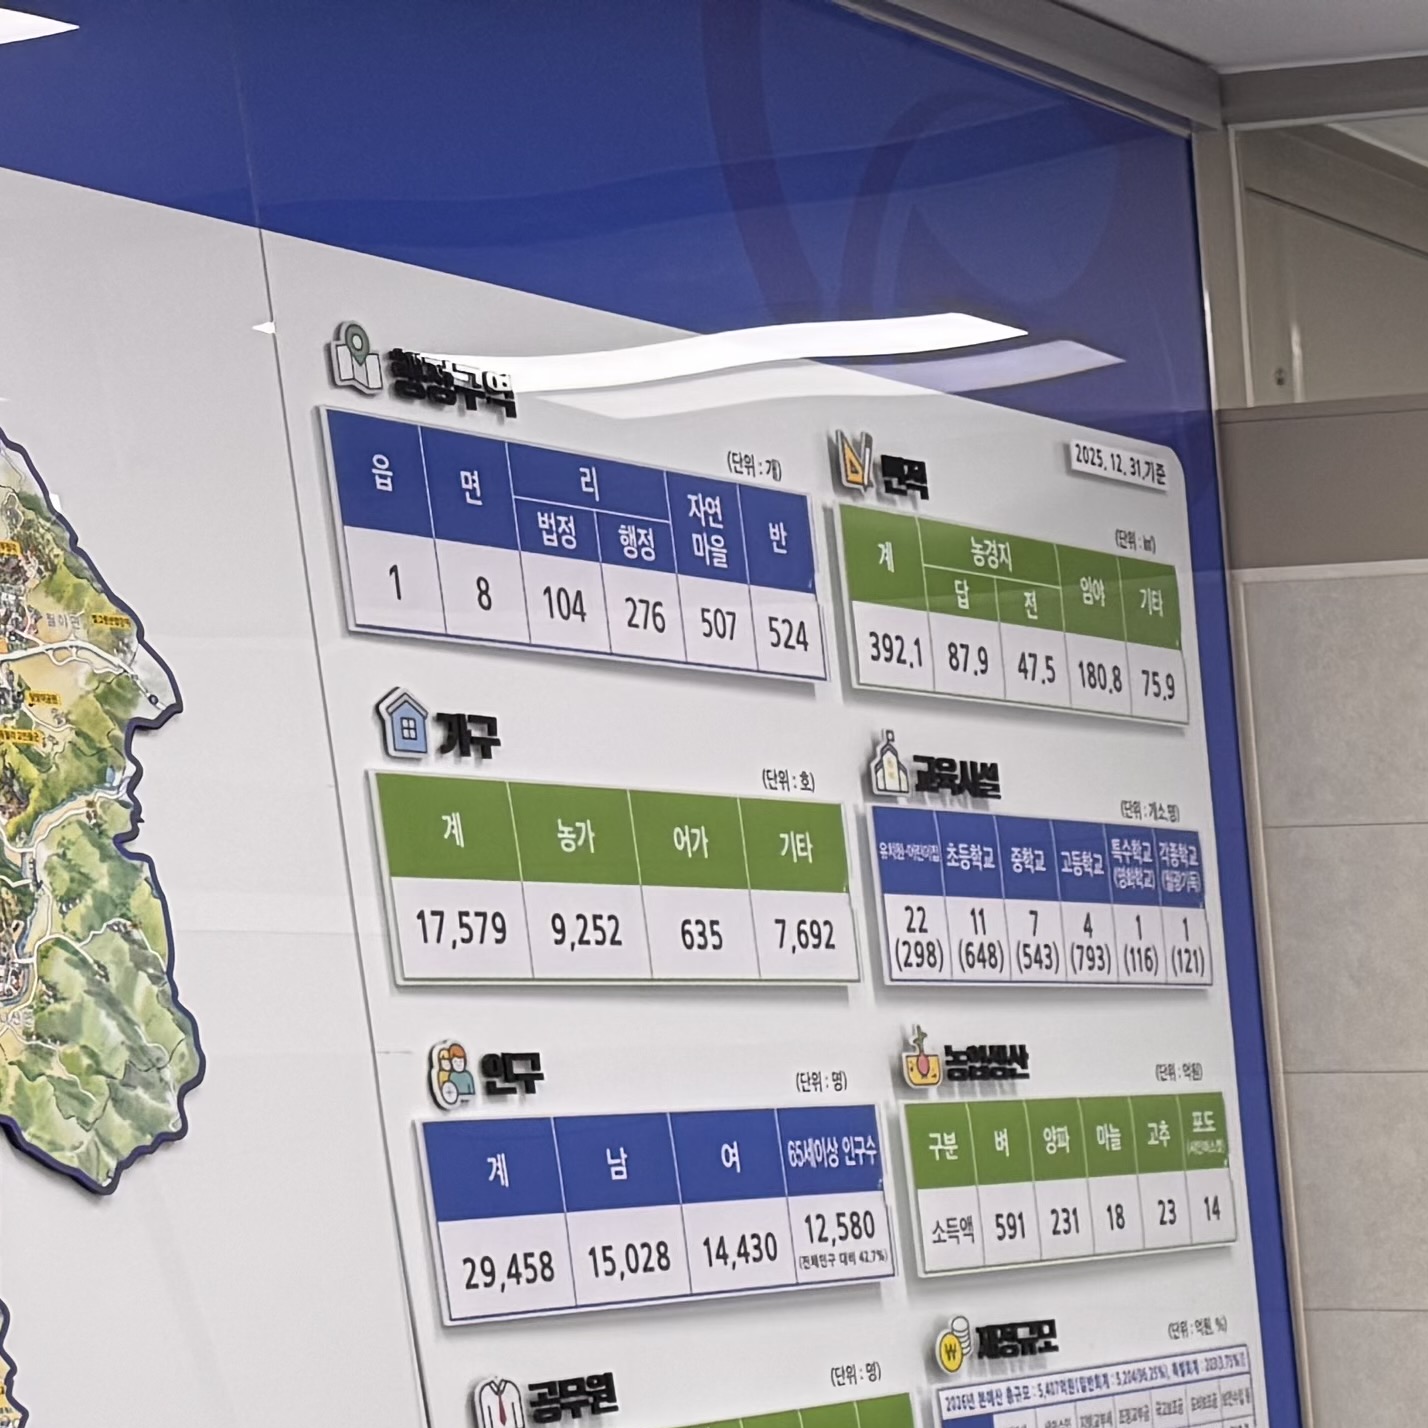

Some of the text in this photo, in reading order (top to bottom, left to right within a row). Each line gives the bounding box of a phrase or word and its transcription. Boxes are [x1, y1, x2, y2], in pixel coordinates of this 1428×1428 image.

[387, 348, 517, 418] 행정구역
[371, 454, 393, 492] 읍
[727, 451, 755, 477] (단위
[1076, 444, 1107, 471] 2025.
[461, 471, 482, 506] 면
[580, 467, 598, 500] 리
[688, 494, 722, 529] 자연
[538, 512, 576, 549] 법정
[618, 528, 655, 561] 행정
[769, 523, 787, 554] 반
[694, 535, 727, 569] 마을
[878, 541, 894, 572] 계
[971, 536, 1012, 572] 농경지
[389, 565, 401, 600] 1
[477, 576, 492, 611] 8
[955, 580, 969, 609] 답
[1080, 577, 1105, 606] 임야
[543, 585, 587, 622] 104
[627, 597, 665, 632] 276
[1024, 591, 1038, 620] 전
[1141, 588, 1163, 617] 기타
[701, 608, 736, 641] 507
[769, 617, 808, 651] 524
[869, 631, 922, 669] 392.1
[949, 643, 989, 675] 87.9
[1018, 652, 1056, 684] 47.5
[1079, 660, 1122, 693] 180.8
[1142, 669, 1175, 700] 75.9
[436, 712, 501, 759] 가구
[762, 769, 789, 791] (단위
[912, 754, 1001, 799] 교육시설
[442, 812, 464, 847] 계
[557, 818, 595, 854] 농가
[673, 826, 708, 859] 어가
[780, 831, 812, 863] 기타
[946, 843, 995, 871] 초등학교
[1011, 848, 1046, 873] 중학교
[1061, 850, 1104, 876] 고등학교
[1111, 839, 1153, 864] 특수학교
[416, 910, 506, 949] 17,579
[551, 913, 622, 951] 9,252
[681, 919, 723, 950] 635
[906, 905, 928, 933] 22
[970, 908, 987, 936] 11
[1029, 910, 1038, 936] 7
[1083, 913, 1093, 939] 4
[1136, 915, 1142, 941] 1
[1183, 918, 1189, 942] 1
[775, 919, 835, 954] 7,692
[895, 939, 944, 973] (298)
[959, 940, 1004, 974] (648)
[1017, 941, 1060, 974] (543)
[1071, 943, 1111, 975] (793)
[1124, 945, 1158, 976] (116)
[1172, 947, 1205, 977] (121)
[481, 1051, 544, 1096] 인구
[796, 1071, 847, 1093] (단위 명)
[1096, 1124, 1121, 1151] 마늘
[1148, 1120, 1170, 1147] 고추
[1192, 1111, 1216, 1133] 포도
[787, 1134, 878, 1168] 65세이상 인구수
[929, 1132, 958, 1160] 구분
[995, 1128, 1009, 1157] 벼
[1044, 1126, 1070, 1154] 양파
[487, 1154, 509, 1187] 계
[606, 1147, 628, 1181] 남
[721, 1141, 741, 1173] 여
[1051, 1207, 1079, 1235] 231
[1107, 1204, 1125, 1230] 18
[1158, 1199, 1176, 1225] 23
[1204, 1196, 1220, 1221] 14
[804, 1210, 875, 1247] 12,580
[932, 1215, 974, 1245] 소득액
[995, 1212, 1025, 1241] 591
[589, 1241, 671, 1281] 15,028
[703, 1232, 778, 1271] 14,430
[462, 1250, 555, 1293] 29,458
[830, 1362, 881, 1387] (단위 명)
[528, 1372, 619, 1424] 공무원
